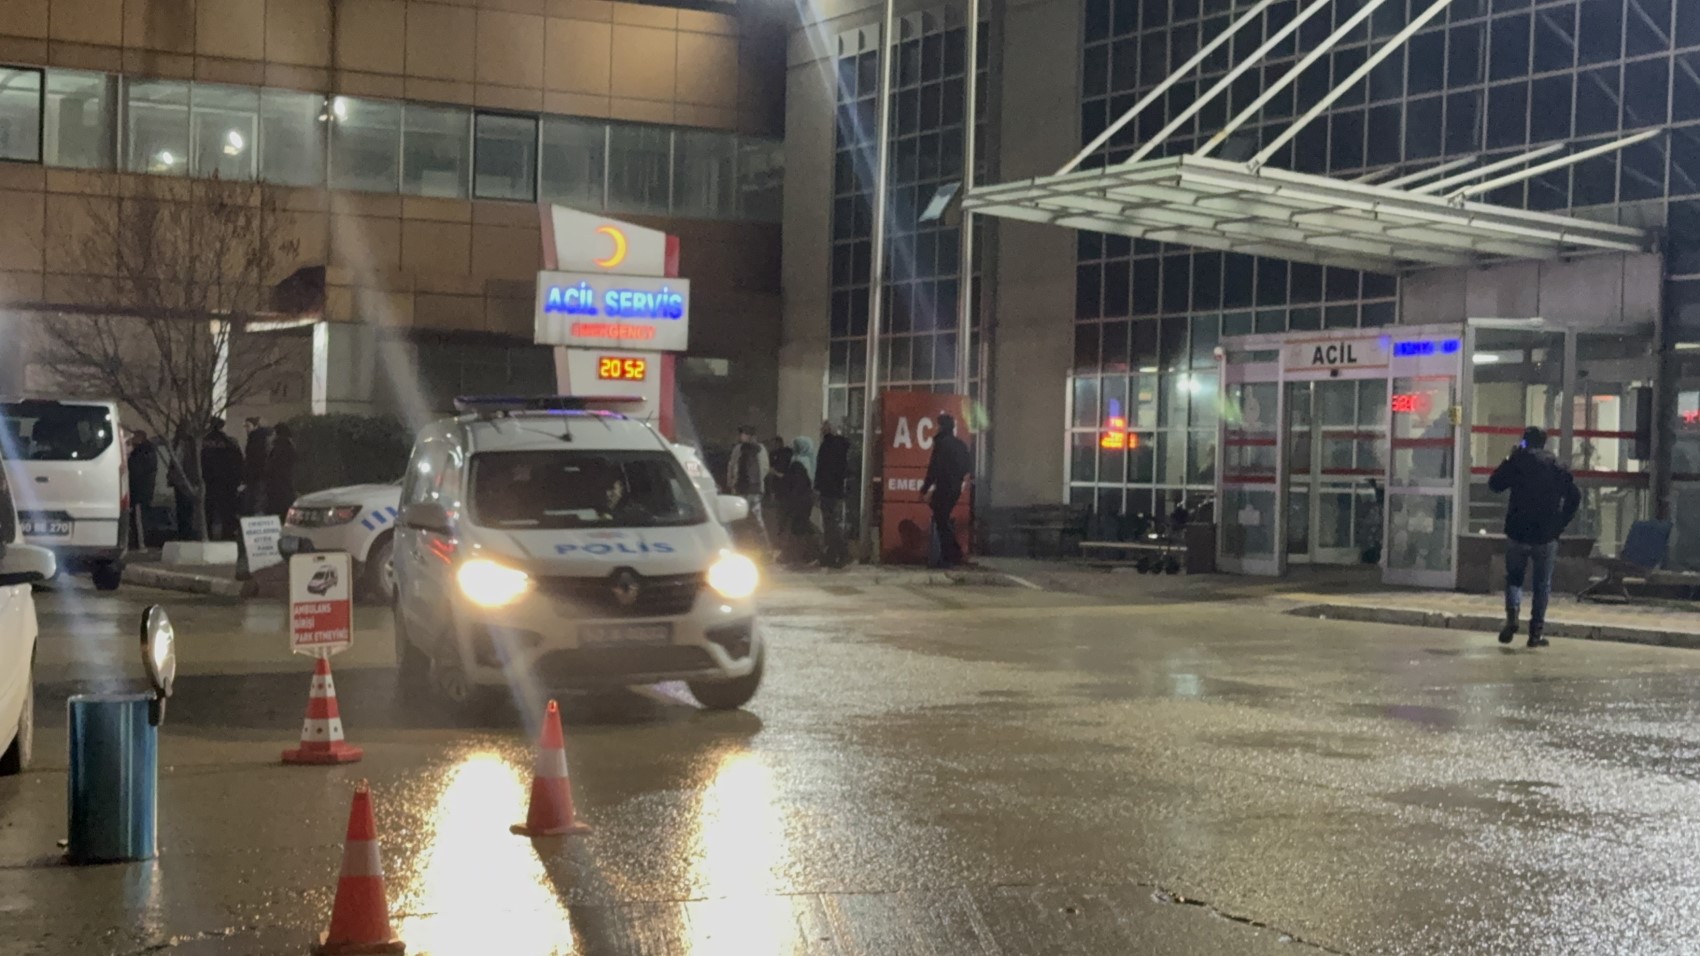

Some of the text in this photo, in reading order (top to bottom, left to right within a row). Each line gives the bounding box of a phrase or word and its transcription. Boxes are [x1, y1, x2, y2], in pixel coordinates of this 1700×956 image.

[605, 287, 683, 319] SERVİS
[1312, 341, 1357, 365] ACİL
[295, 603, 331, 614] AMBULANS
